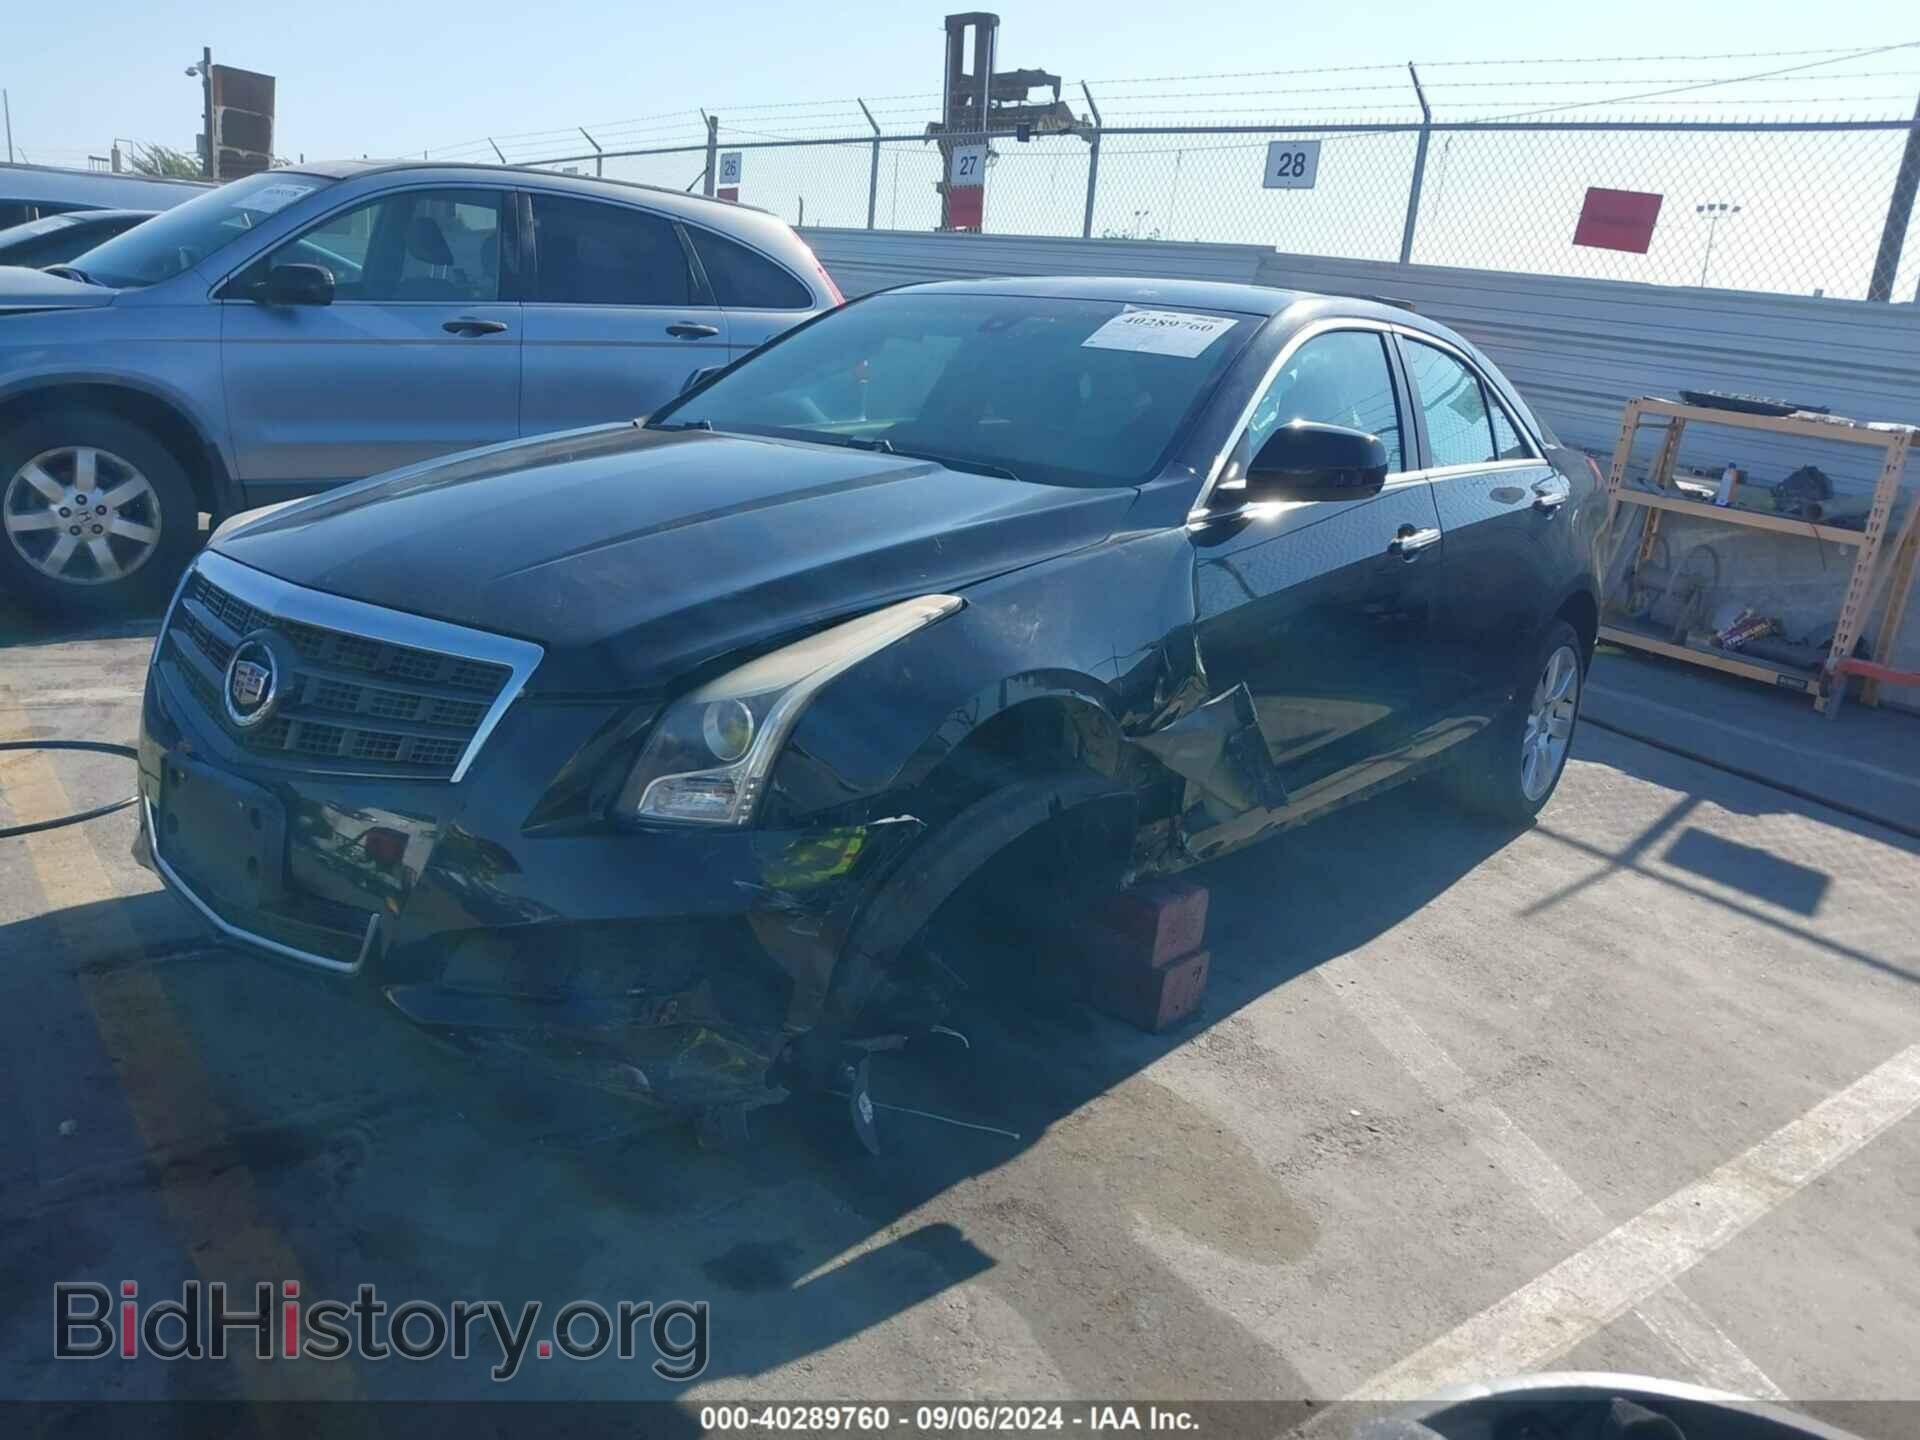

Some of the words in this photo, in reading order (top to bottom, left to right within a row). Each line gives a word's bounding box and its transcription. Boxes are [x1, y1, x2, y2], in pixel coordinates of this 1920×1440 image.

[724, 159, 737, 176] 26
[959, 155, 978, 175] 27
[1277, 152, 1306, 177] 28
[1123, 316, 1214, 332] 40289760
